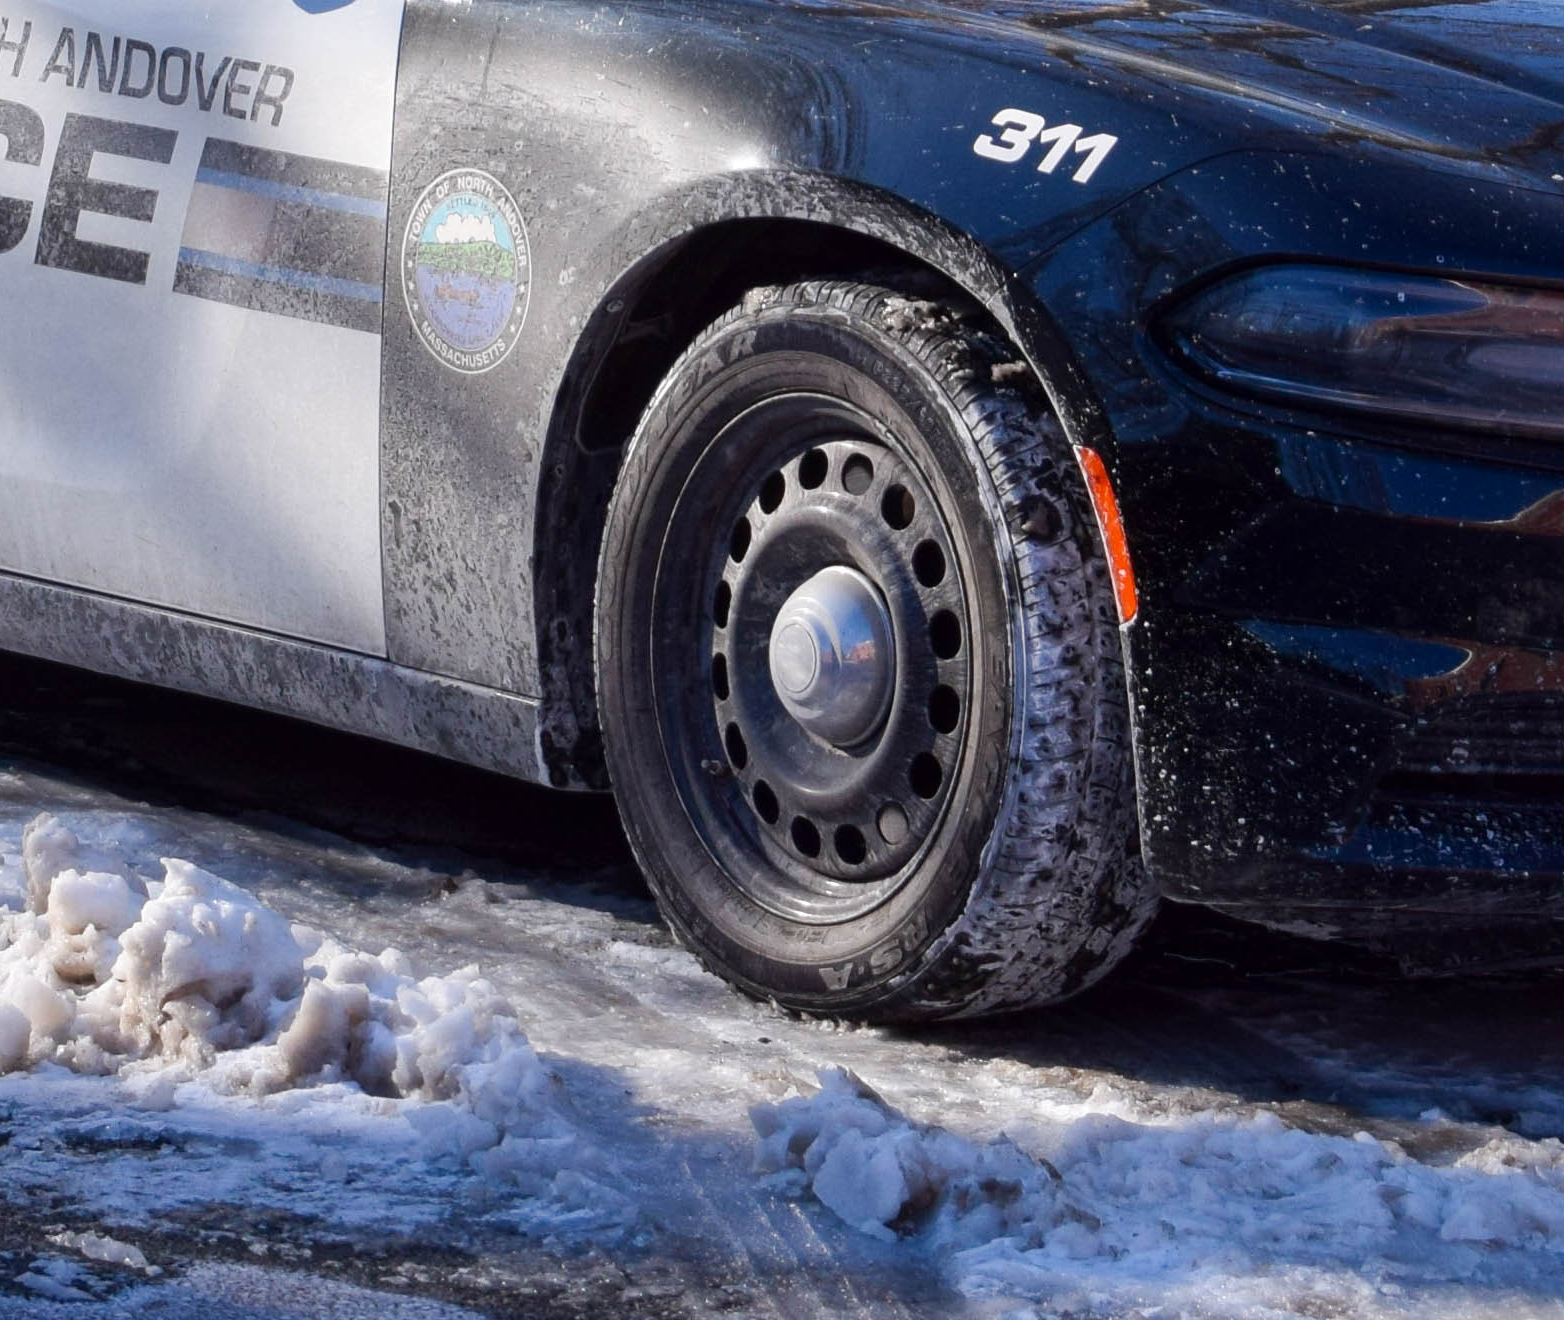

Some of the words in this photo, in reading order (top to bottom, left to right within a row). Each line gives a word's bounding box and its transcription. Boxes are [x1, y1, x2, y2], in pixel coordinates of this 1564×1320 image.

[41, 27, 296, 127] ANDOVER
[973, 108, 1118, 184] 311
[408, 198, 433, 242] TOWN
[436, 180, 450, 199] OF
[457, 176, 494, 198] NORTH
[497, 197, 527, 267] ANDOVER
[421, 320, 506, 368] MASSACHUSETTS
